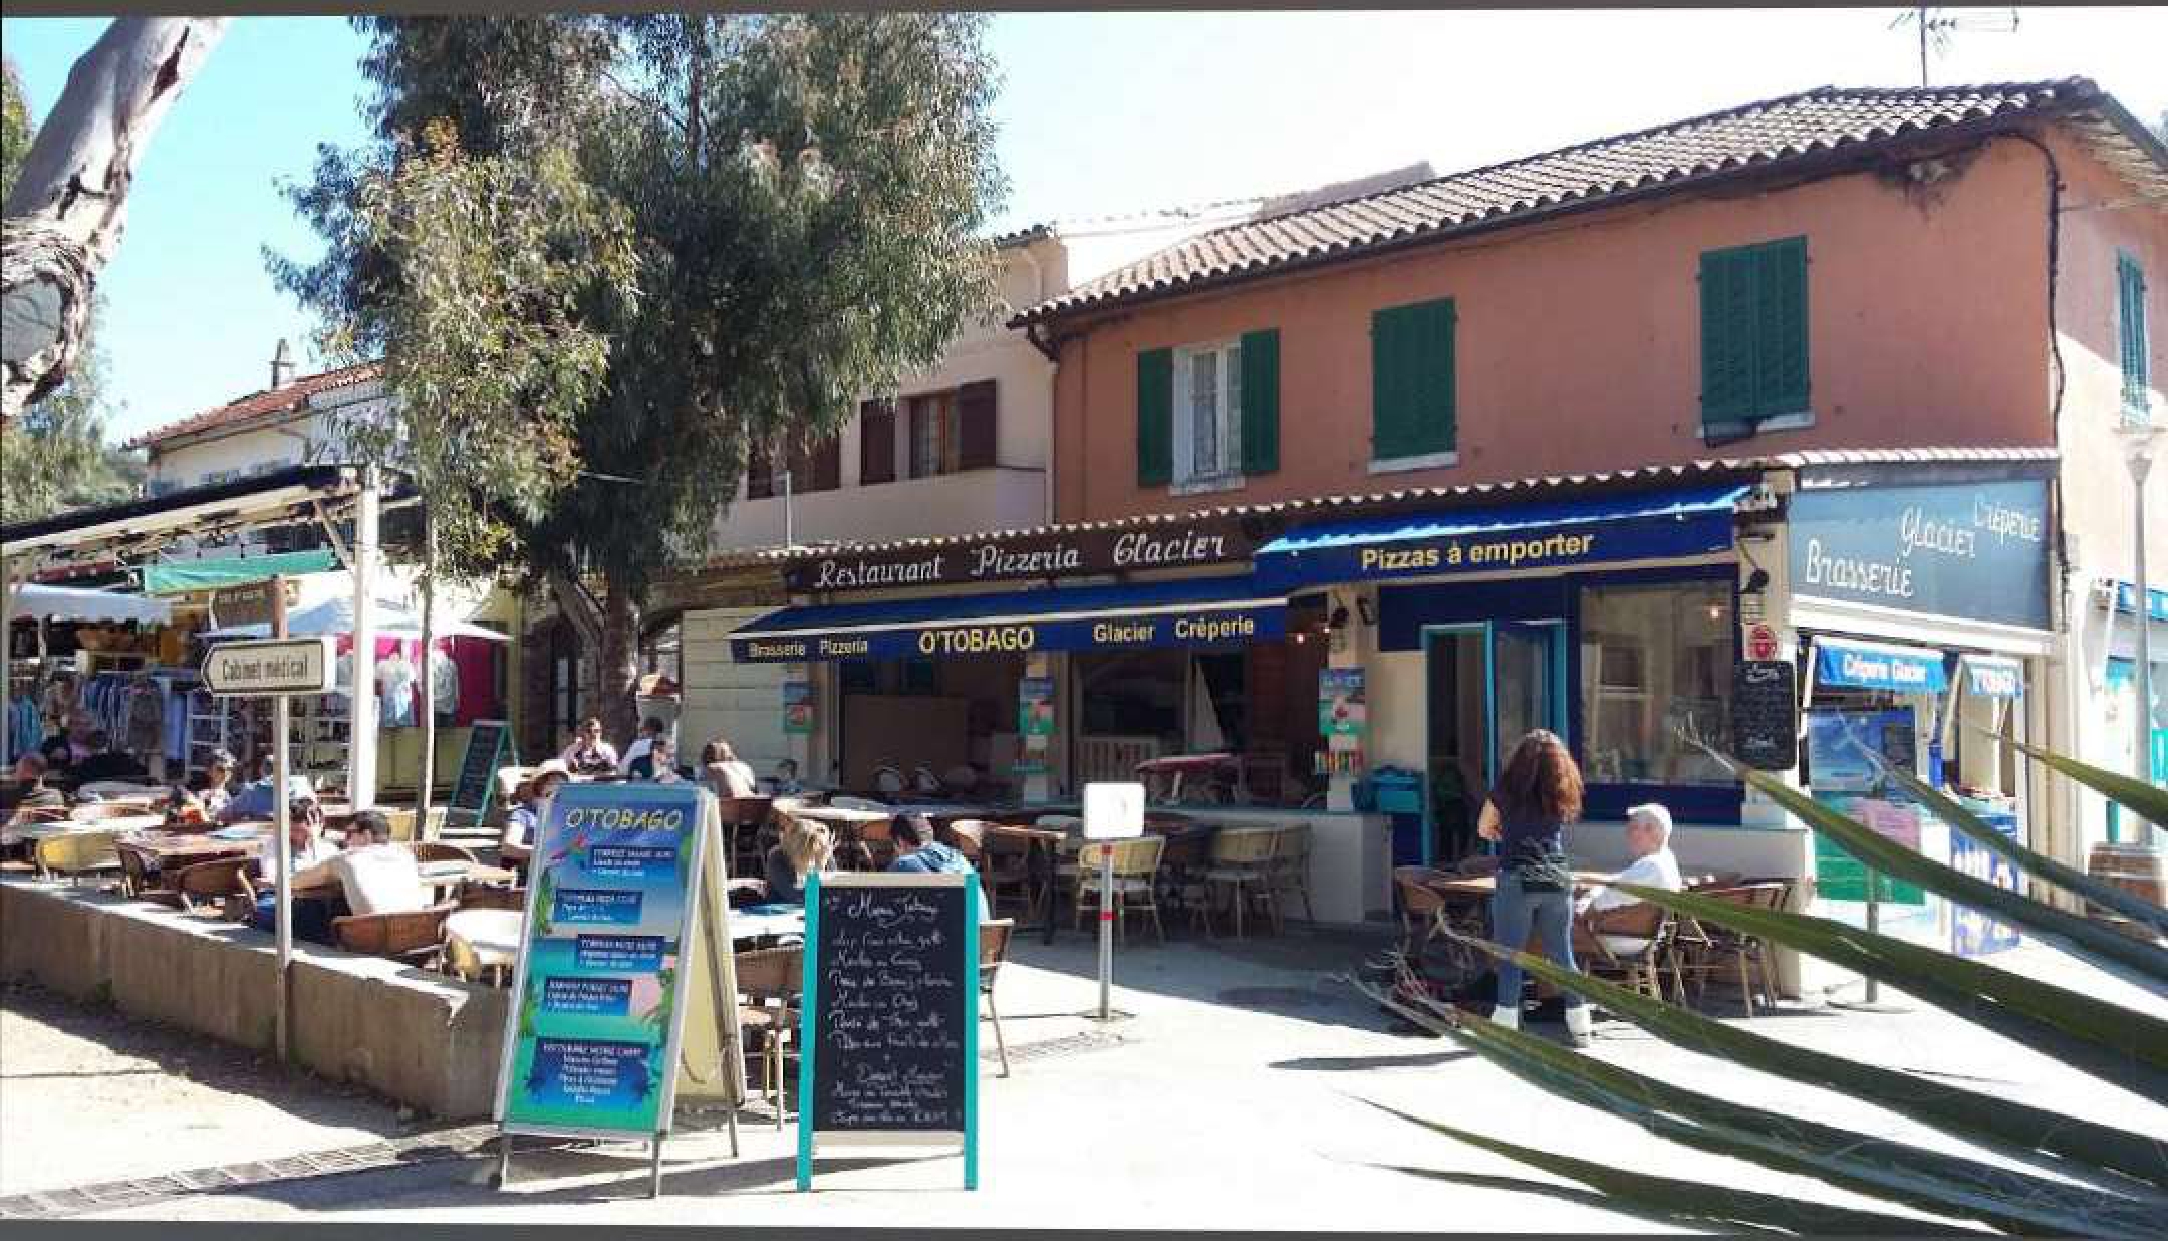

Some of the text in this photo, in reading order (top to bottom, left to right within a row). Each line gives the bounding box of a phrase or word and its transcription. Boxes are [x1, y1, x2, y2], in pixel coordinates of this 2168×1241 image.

[1900, 506, 1976, 559] Glacier
[813, 531, 1226, 589] Restaurant Pizzeria Glacier
[1361, 533, 1595, 571] Pizzas à emporter
[1806, 537, 1914, 597] Brasserie
[918, 626, 1036, 654] O'TOBAGO
[1093, 615, 1254, 645] Glacier Crêperie
[748, 637, 868, 658] Brasserie Pizzeria
[222, 653, 308, 681] Cabinet médical
[565, 807, 684, 832] O'TOBAGO
